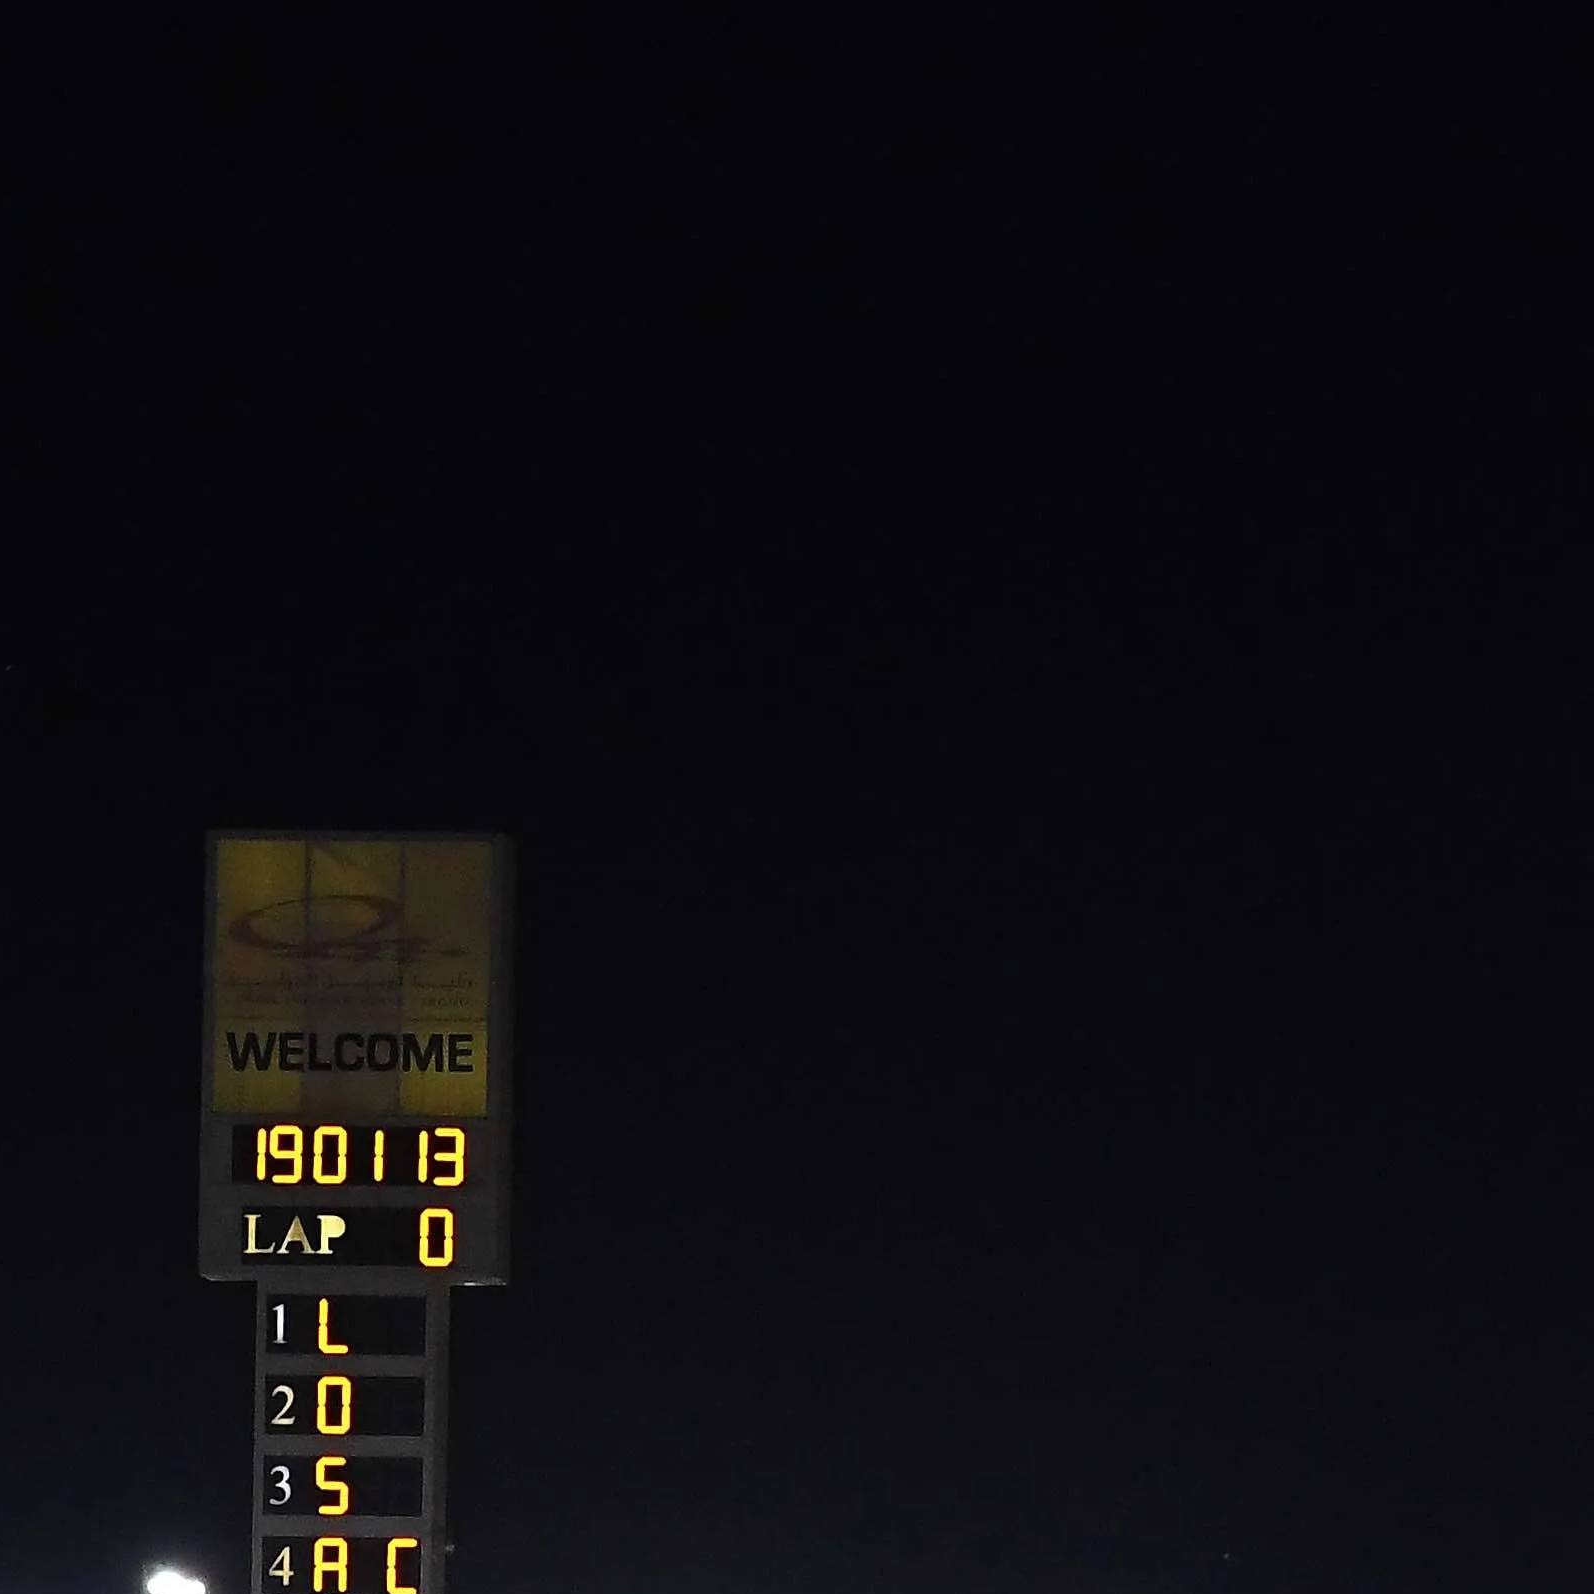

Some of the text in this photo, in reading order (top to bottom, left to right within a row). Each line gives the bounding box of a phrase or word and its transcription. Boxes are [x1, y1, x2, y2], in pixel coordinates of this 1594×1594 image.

[227, 1032, 474, 1073] WELCOME
[243, 1209, 454, 1267] LAP 0
[272, 1298, 349, 1354] 1 L
[271, 1385, 296, 1425] 2
[269, 1465, 292, 1505] 3
[269, 1546, 295, 1587] 4
[313, 1537, 348, 1593] A
